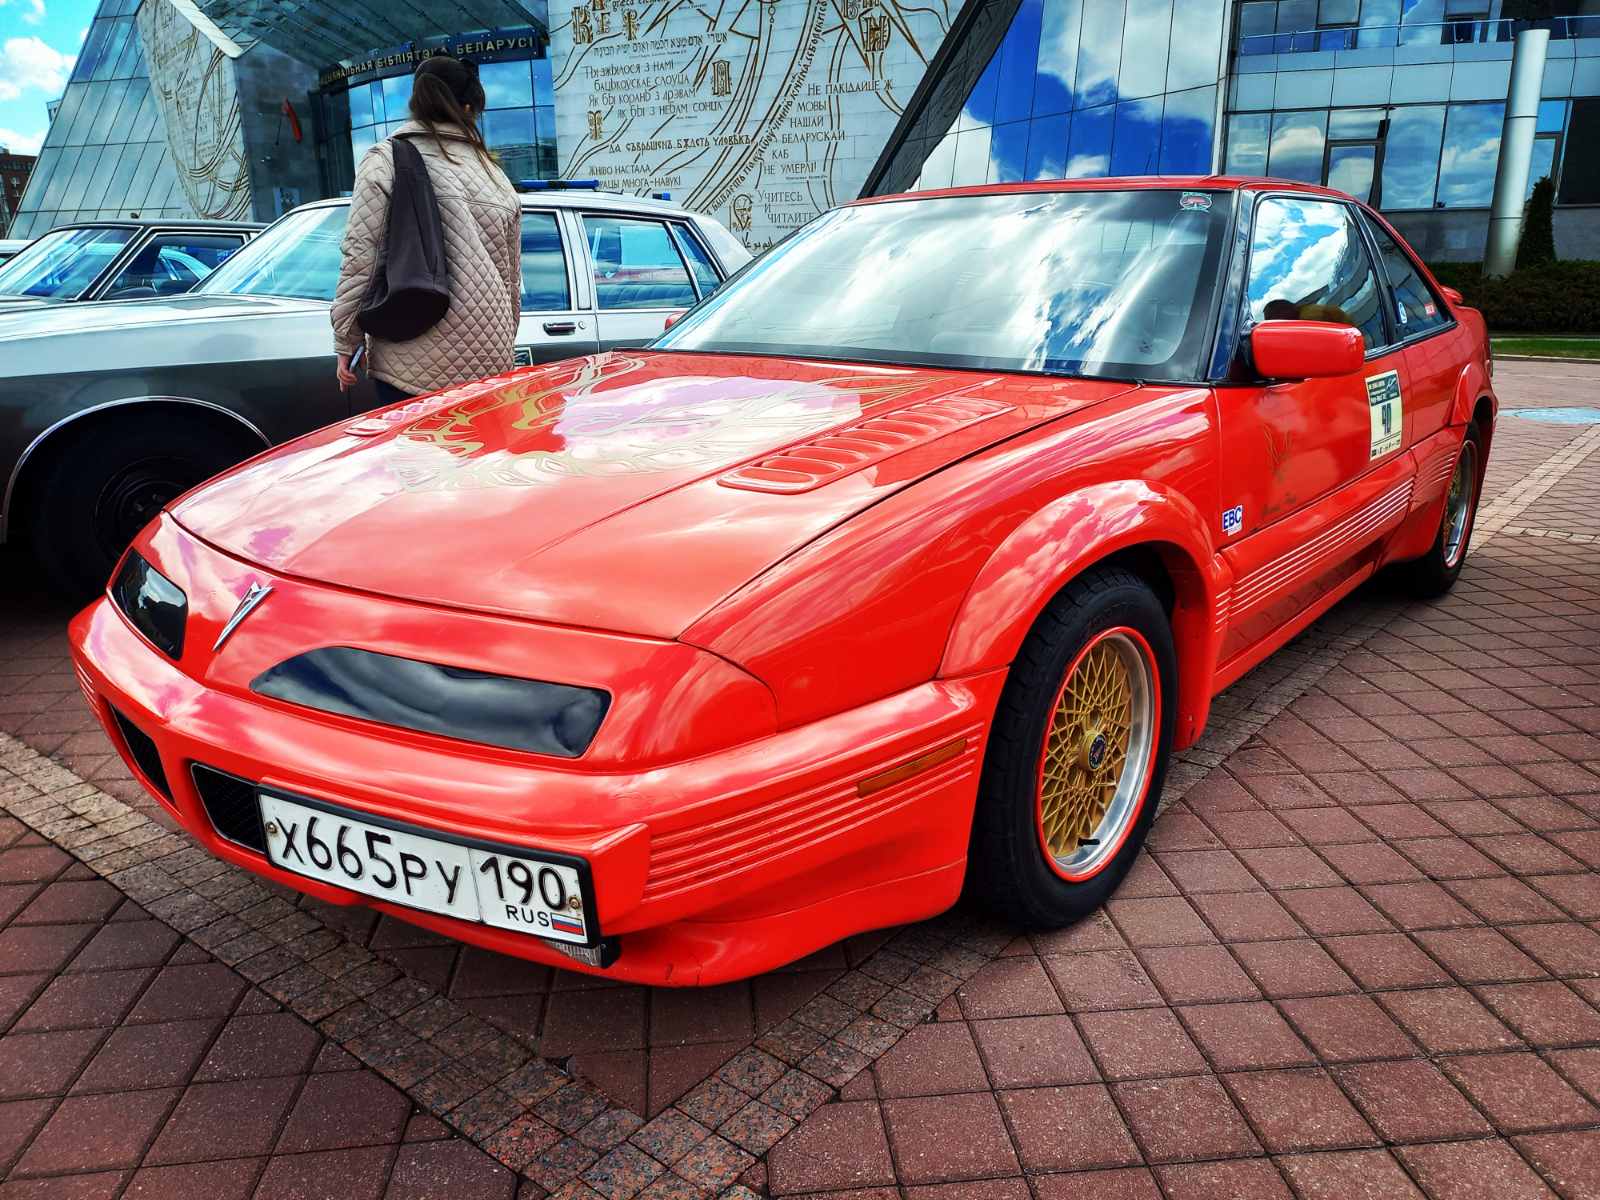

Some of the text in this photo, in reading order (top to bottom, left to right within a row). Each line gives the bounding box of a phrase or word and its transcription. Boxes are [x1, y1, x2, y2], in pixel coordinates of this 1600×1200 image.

[456, 38, 533, 55] БЕЛАРУСІ
[807, 83, 822, 96] НЕ
[796, 100, 827, 113] МОВЫ
[771, 148, 789, 160] КАБ
[763, 164, 776, 176] НЕ
[758, 190, 803, 202] УЧИТЕСЬ
[764, 202, 771, 213] И
[1223, 506, 1242, 530] EBC
[480, 855, 567, 911] 190
[504, 904, 551, 928] RUS
